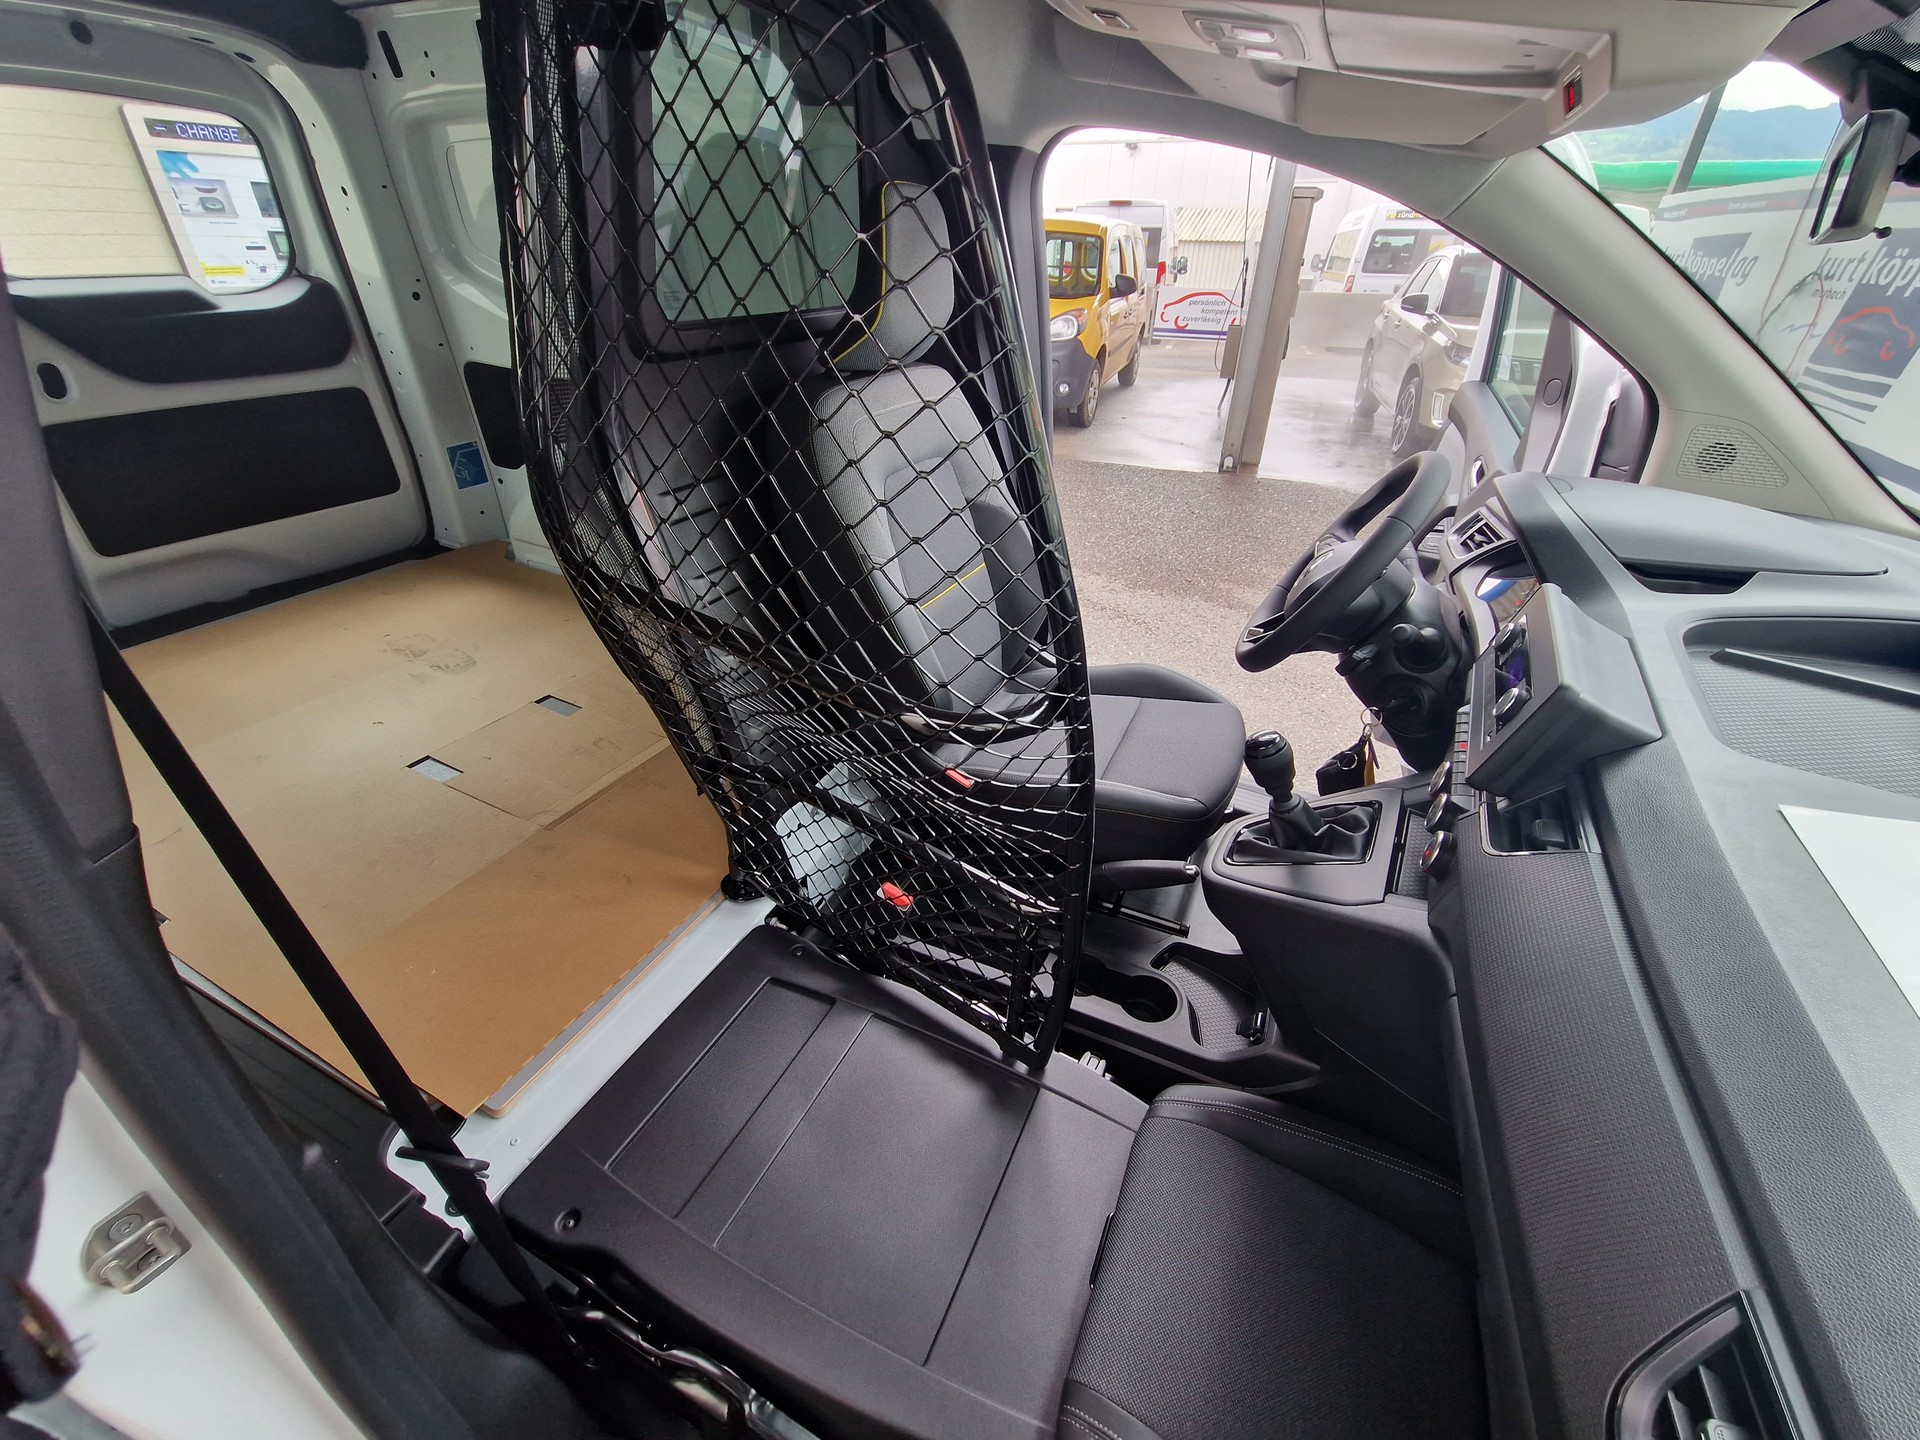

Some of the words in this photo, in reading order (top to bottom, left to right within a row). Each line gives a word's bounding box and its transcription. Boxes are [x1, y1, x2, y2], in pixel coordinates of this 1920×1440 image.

[175, 123, 242, 142] CHANGE
[1811, 247, 1869, 284] kurt
[1189, 299, 1227, 307] persönlich
[1182, 315, 1222, 325] zuverlässig
